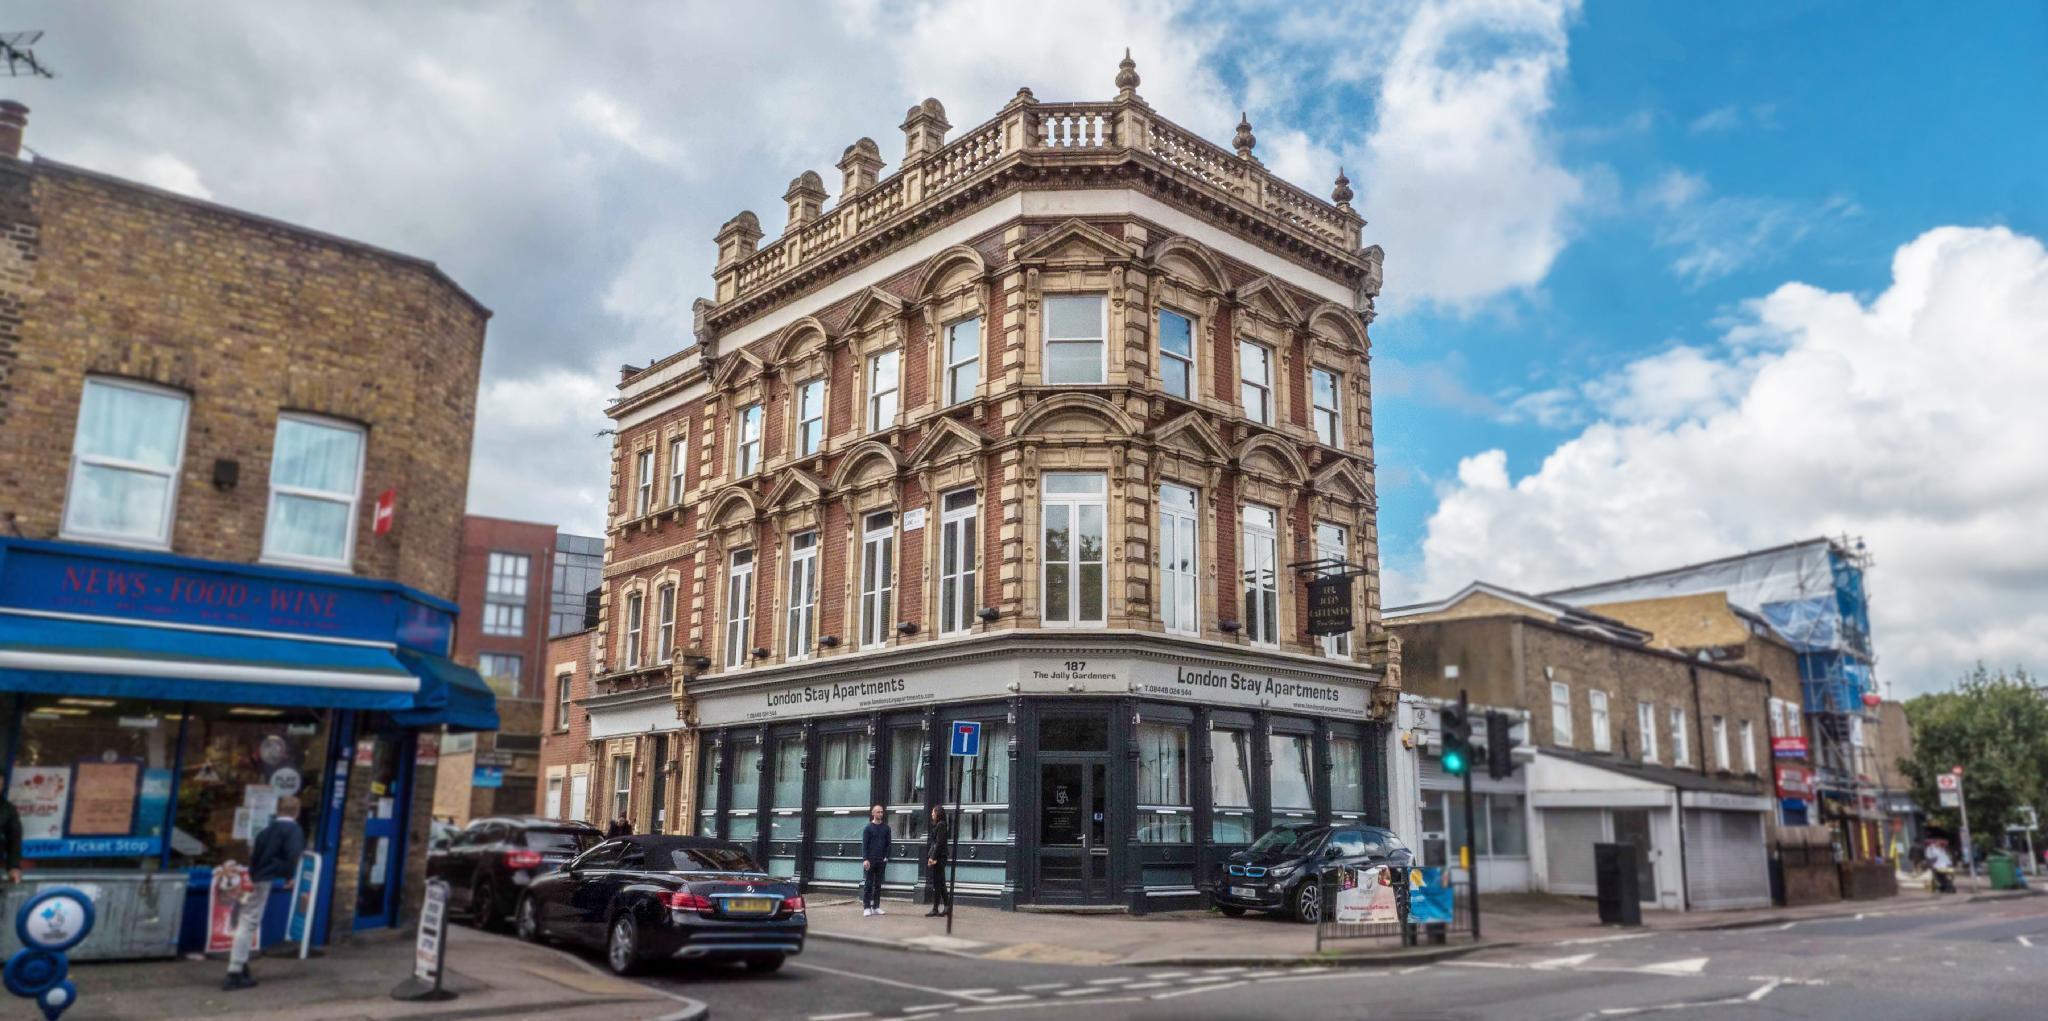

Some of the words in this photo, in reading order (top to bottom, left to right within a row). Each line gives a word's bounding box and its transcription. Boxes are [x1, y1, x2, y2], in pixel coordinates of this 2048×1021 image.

[61, 565, 148, 597] NEWS
[169, 575, 249, 608] FOOD
[269, 587, 341, 619] WINE
[1033, 671, 1049, 679] The
[1050, 671, 1071, 680] Jolly
[1072, 672, 1117, 680] Gardeners
[1064, 662, 1086, 672] 187
[767, 690, 803, 707] London
[804, 687, 831, 703] Stay
[832, 678, 906, 701] Apartments
[1177, 667, 1228, 688] London
[1230, 674, 1261, 695] Stay
[1264, 678, 1340, 702] Apartments
[68, 840, 112, 852] Ticket
[116, 839, 149, 854] Stop
